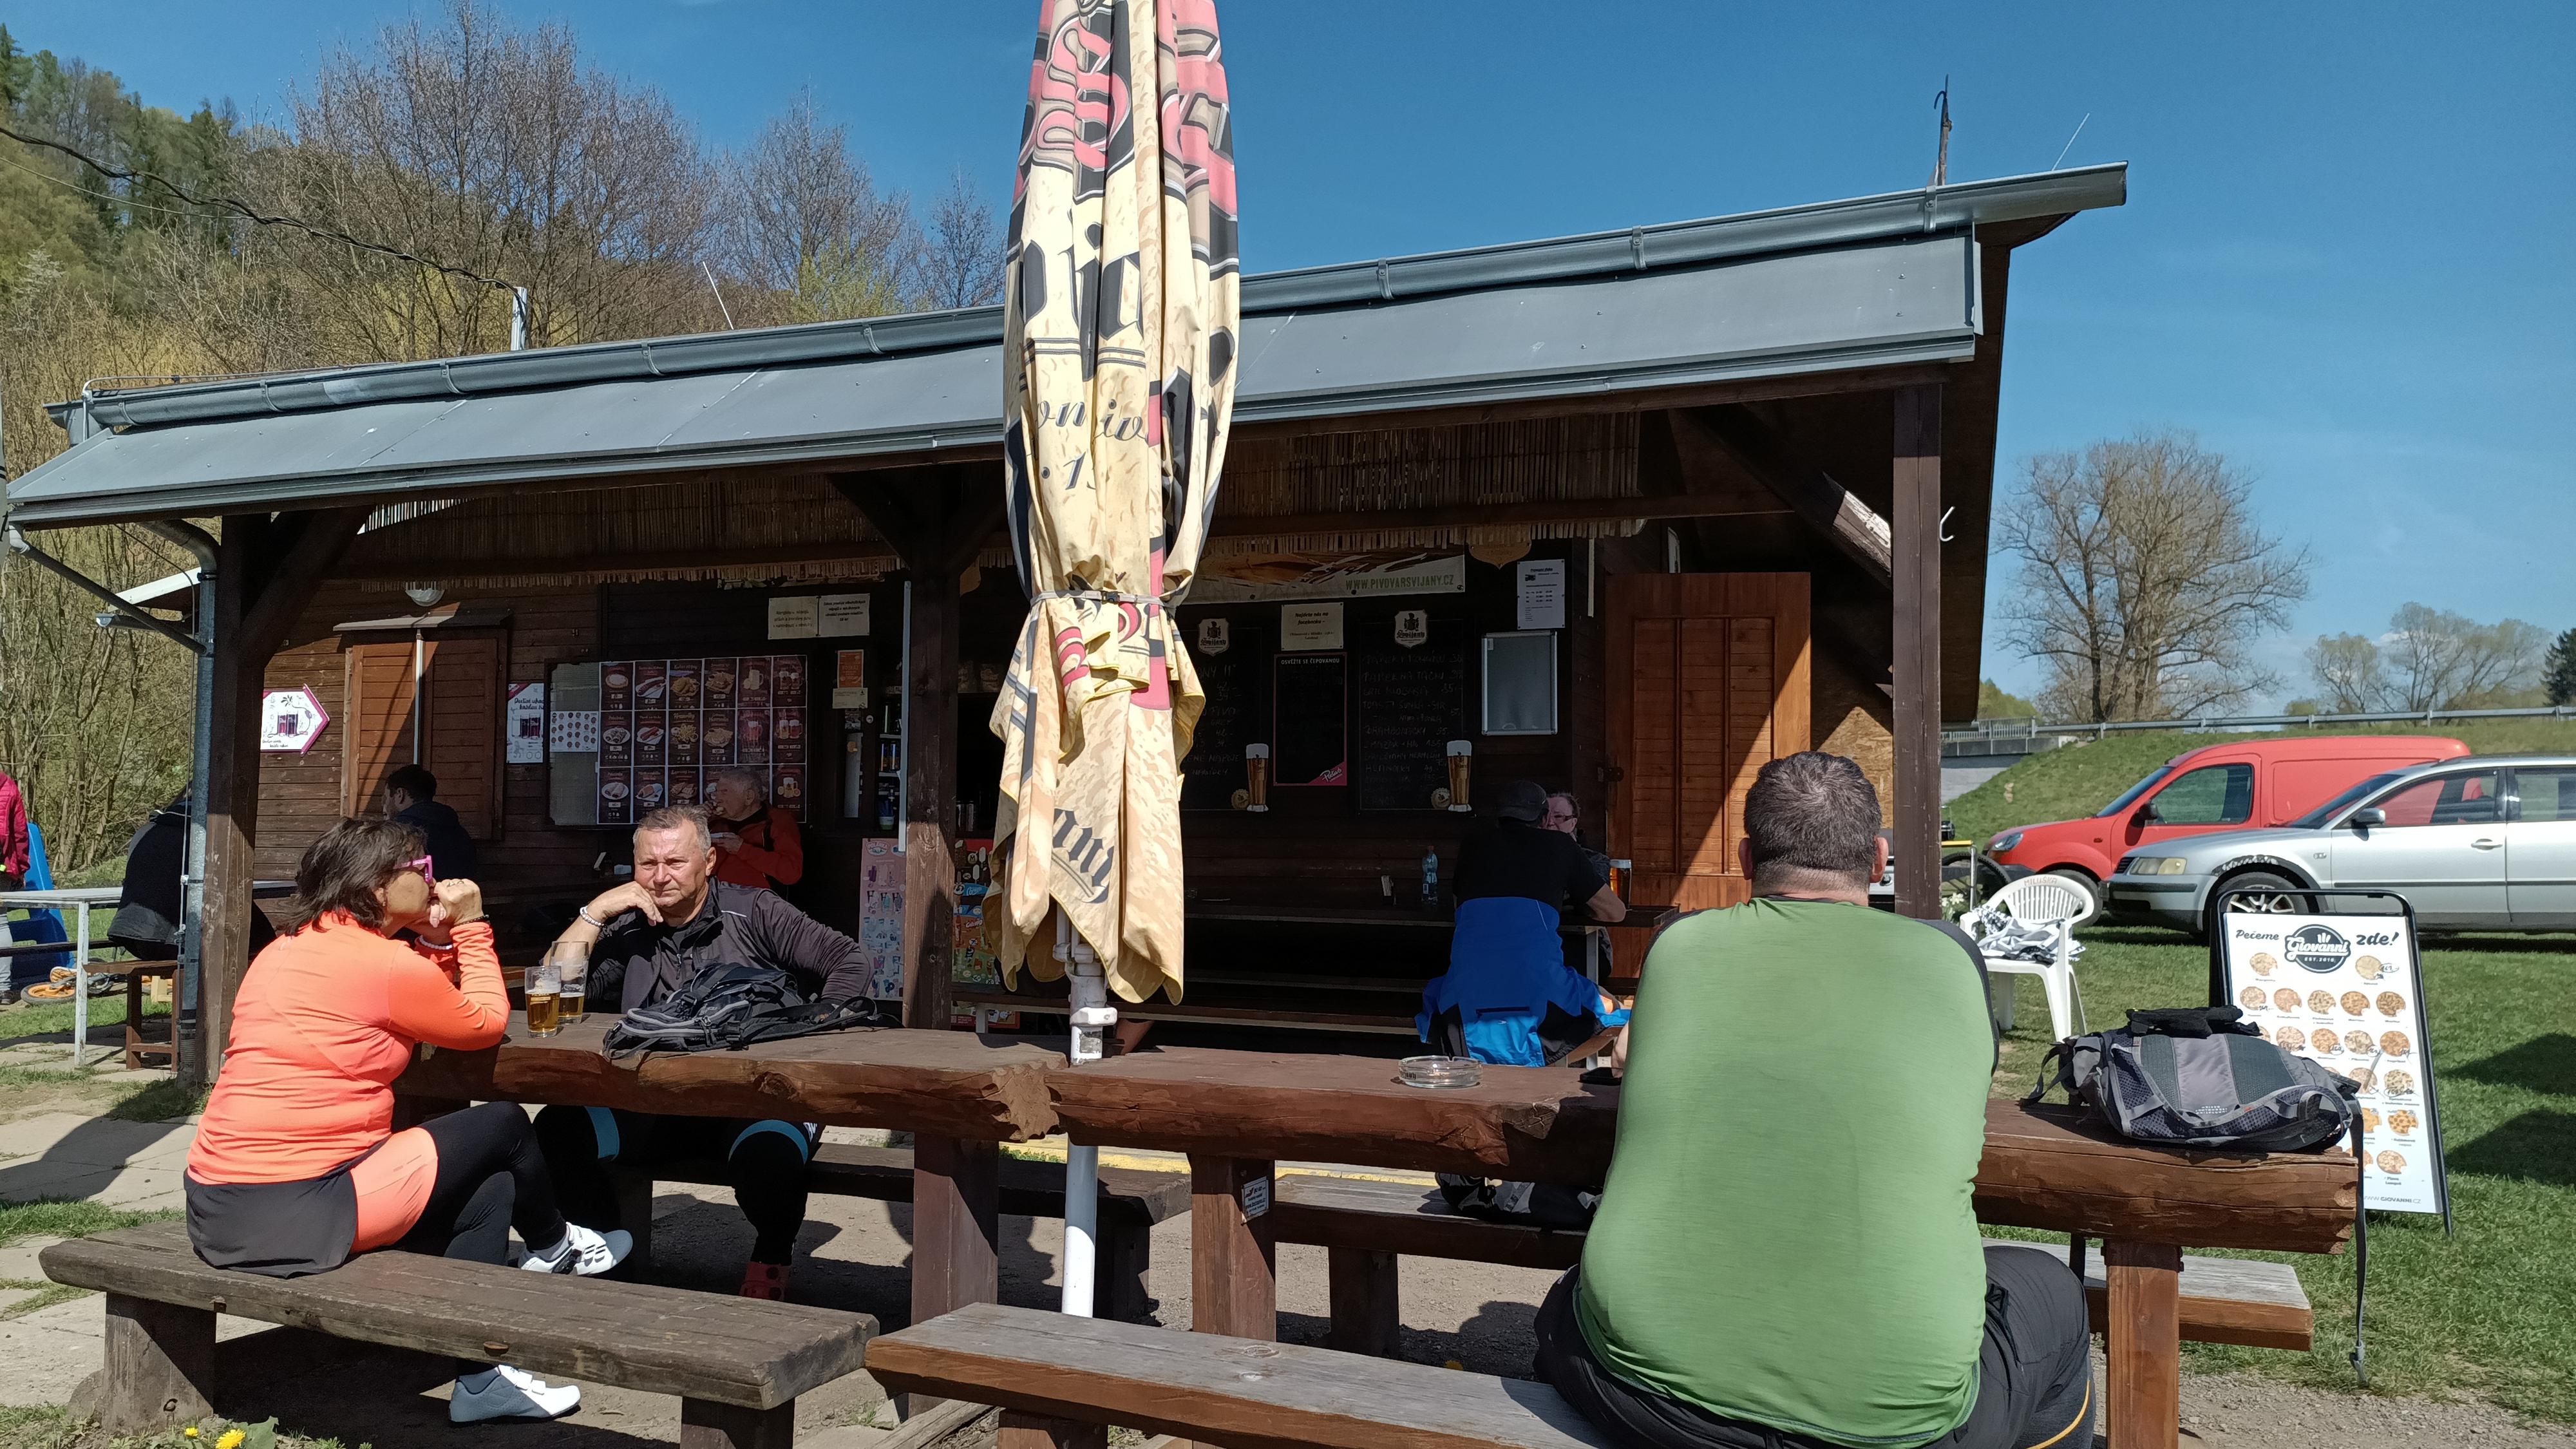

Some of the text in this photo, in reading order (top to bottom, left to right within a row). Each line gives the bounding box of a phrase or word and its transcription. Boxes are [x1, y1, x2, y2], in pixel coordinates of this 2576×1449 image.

[1346, 574, 1454, 590] WWW.PIVOVARSVIJANY.CZ
[2023, 876, 2057, 886] MILUŠKA
[2235, 929, 2400, 961] Pečeme Giovanni zde!
